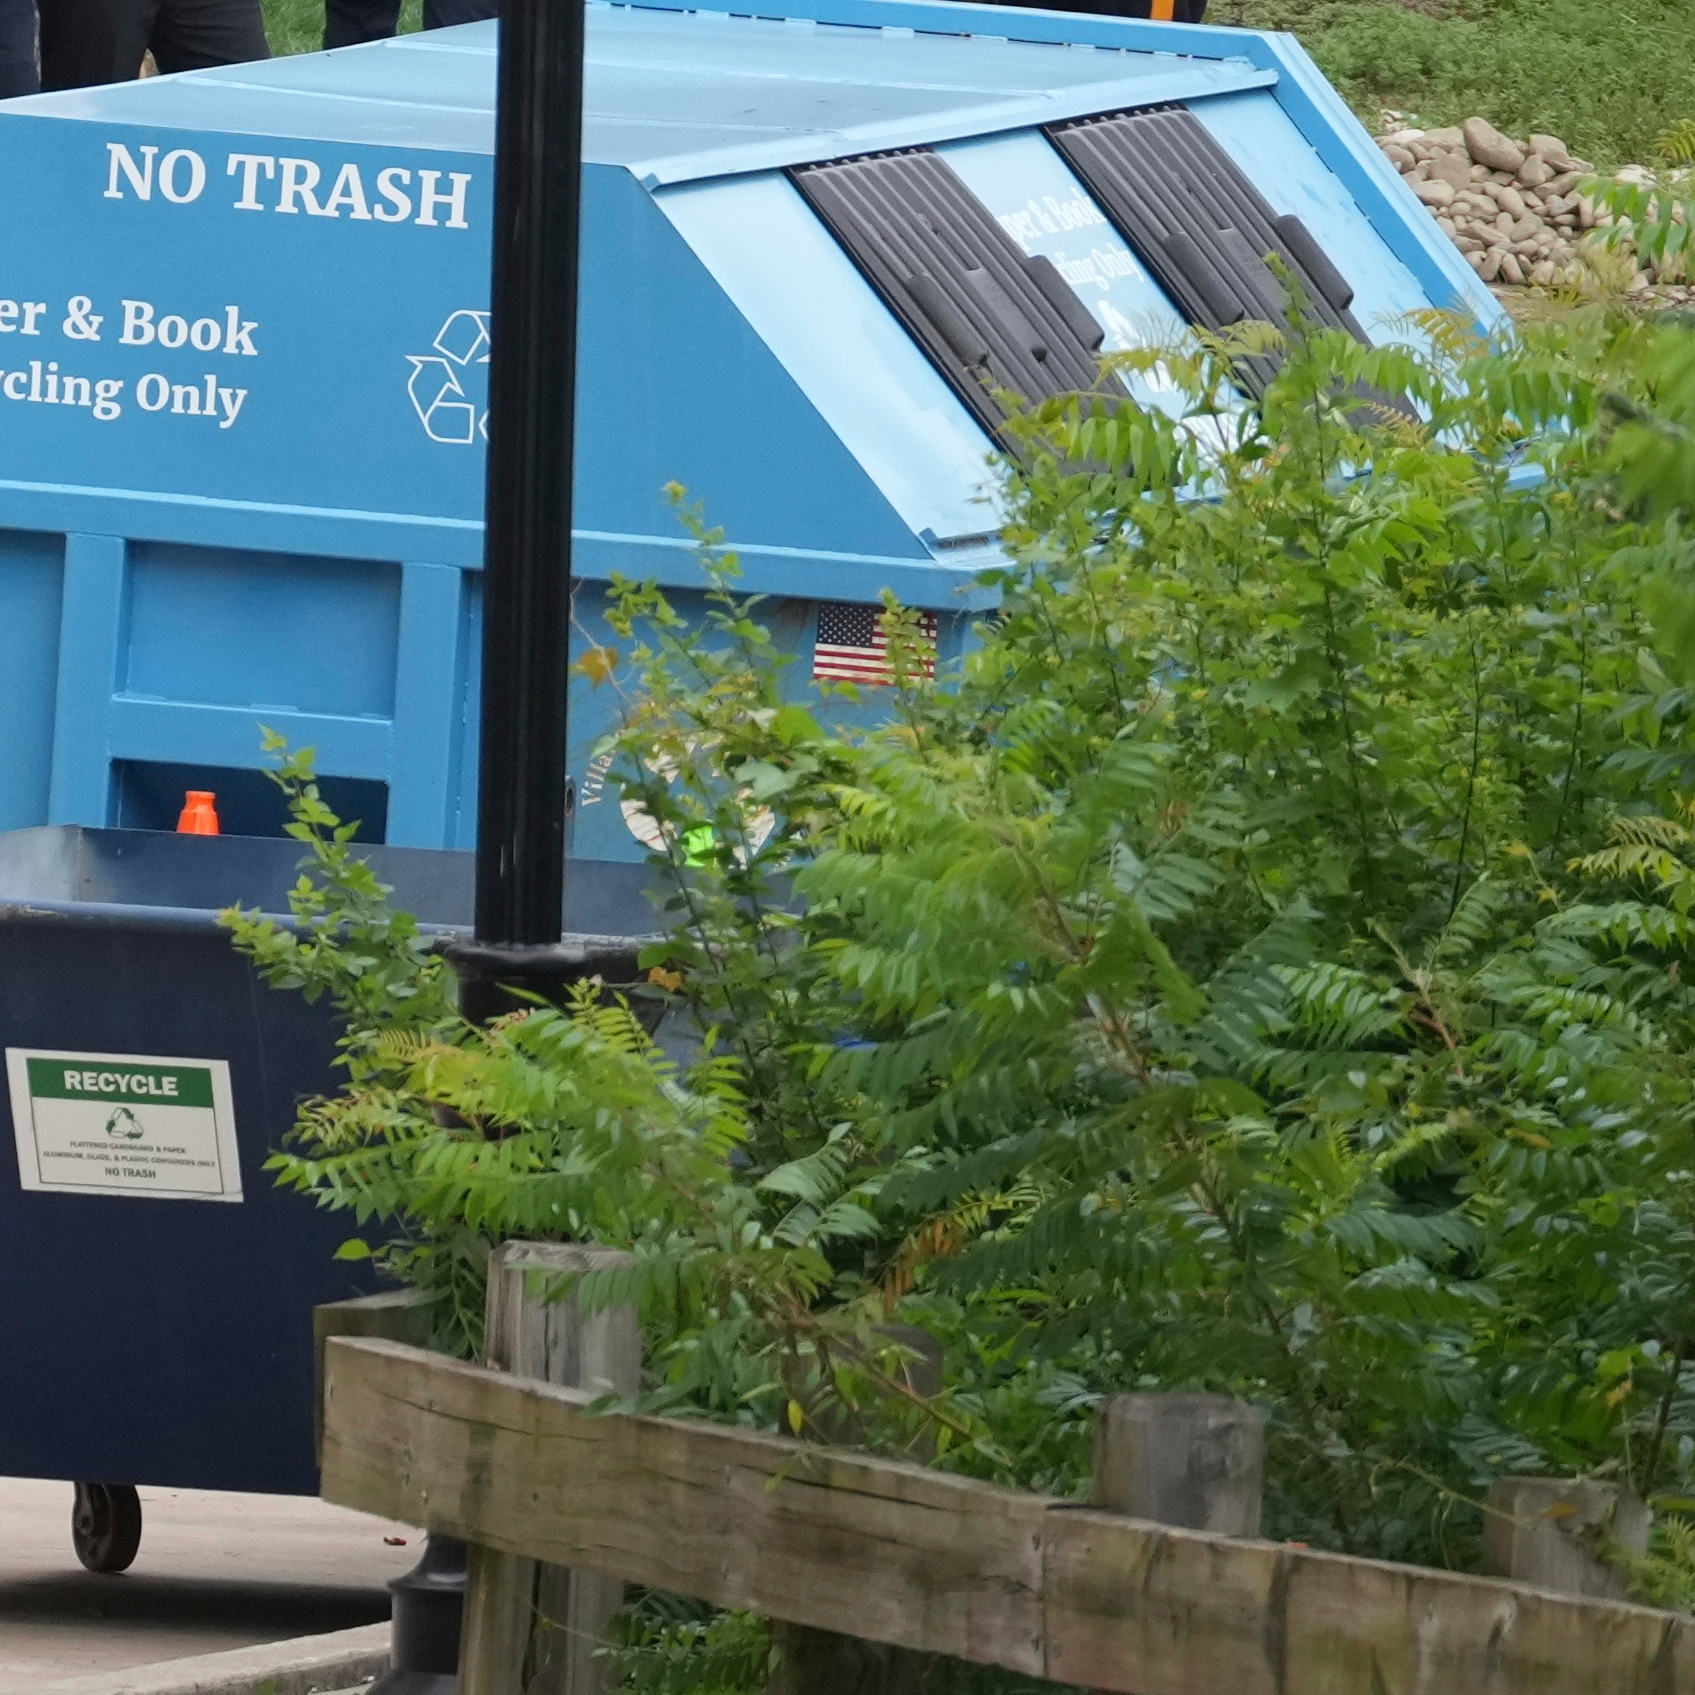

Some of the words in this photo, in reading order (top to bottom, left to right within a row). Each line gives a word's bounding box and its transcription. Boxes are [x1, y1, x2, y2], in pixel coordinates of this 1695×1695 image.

[103, 142, 206, 204] NO
[227, 153, 472, 229] TRASH
[62, 294, 104, 342] &
[118, 299, 259, 356] Book
[136, 373, 248, 429] Only
[581, 752, 614, 807] Villa
[63, 1070, 179, 1096] RECYCLE
[104, 1166, 120, 1176] NO
[122, 1167, 156, 1179] TRASH
